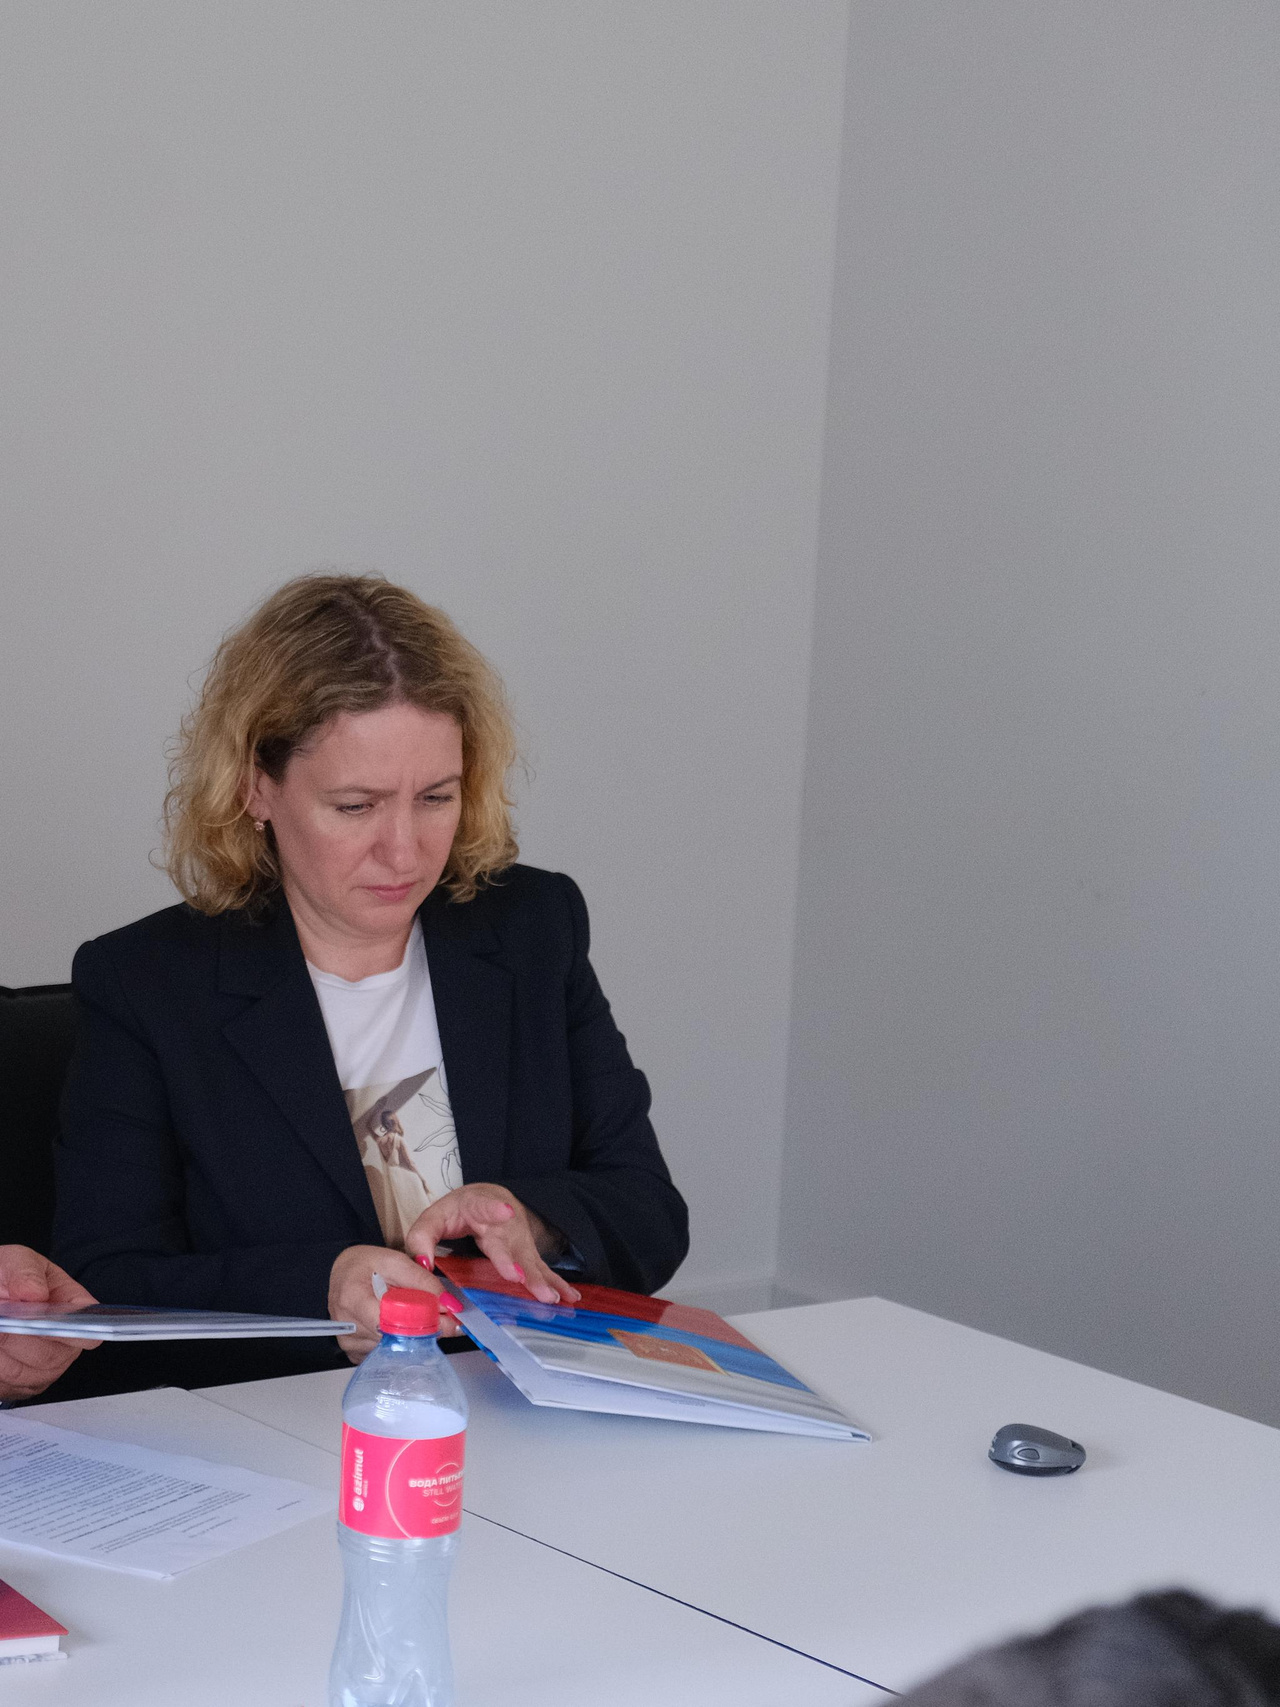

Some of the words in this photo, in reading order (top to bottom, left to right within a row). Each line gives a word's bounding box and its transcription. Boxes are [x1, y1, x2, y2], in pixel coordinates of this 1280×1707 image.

[353, 1448, 364, 1496] azimut
[409, 1478, 437, 1488] ВОДА
[422, 1488, 444, 1497] STILL
